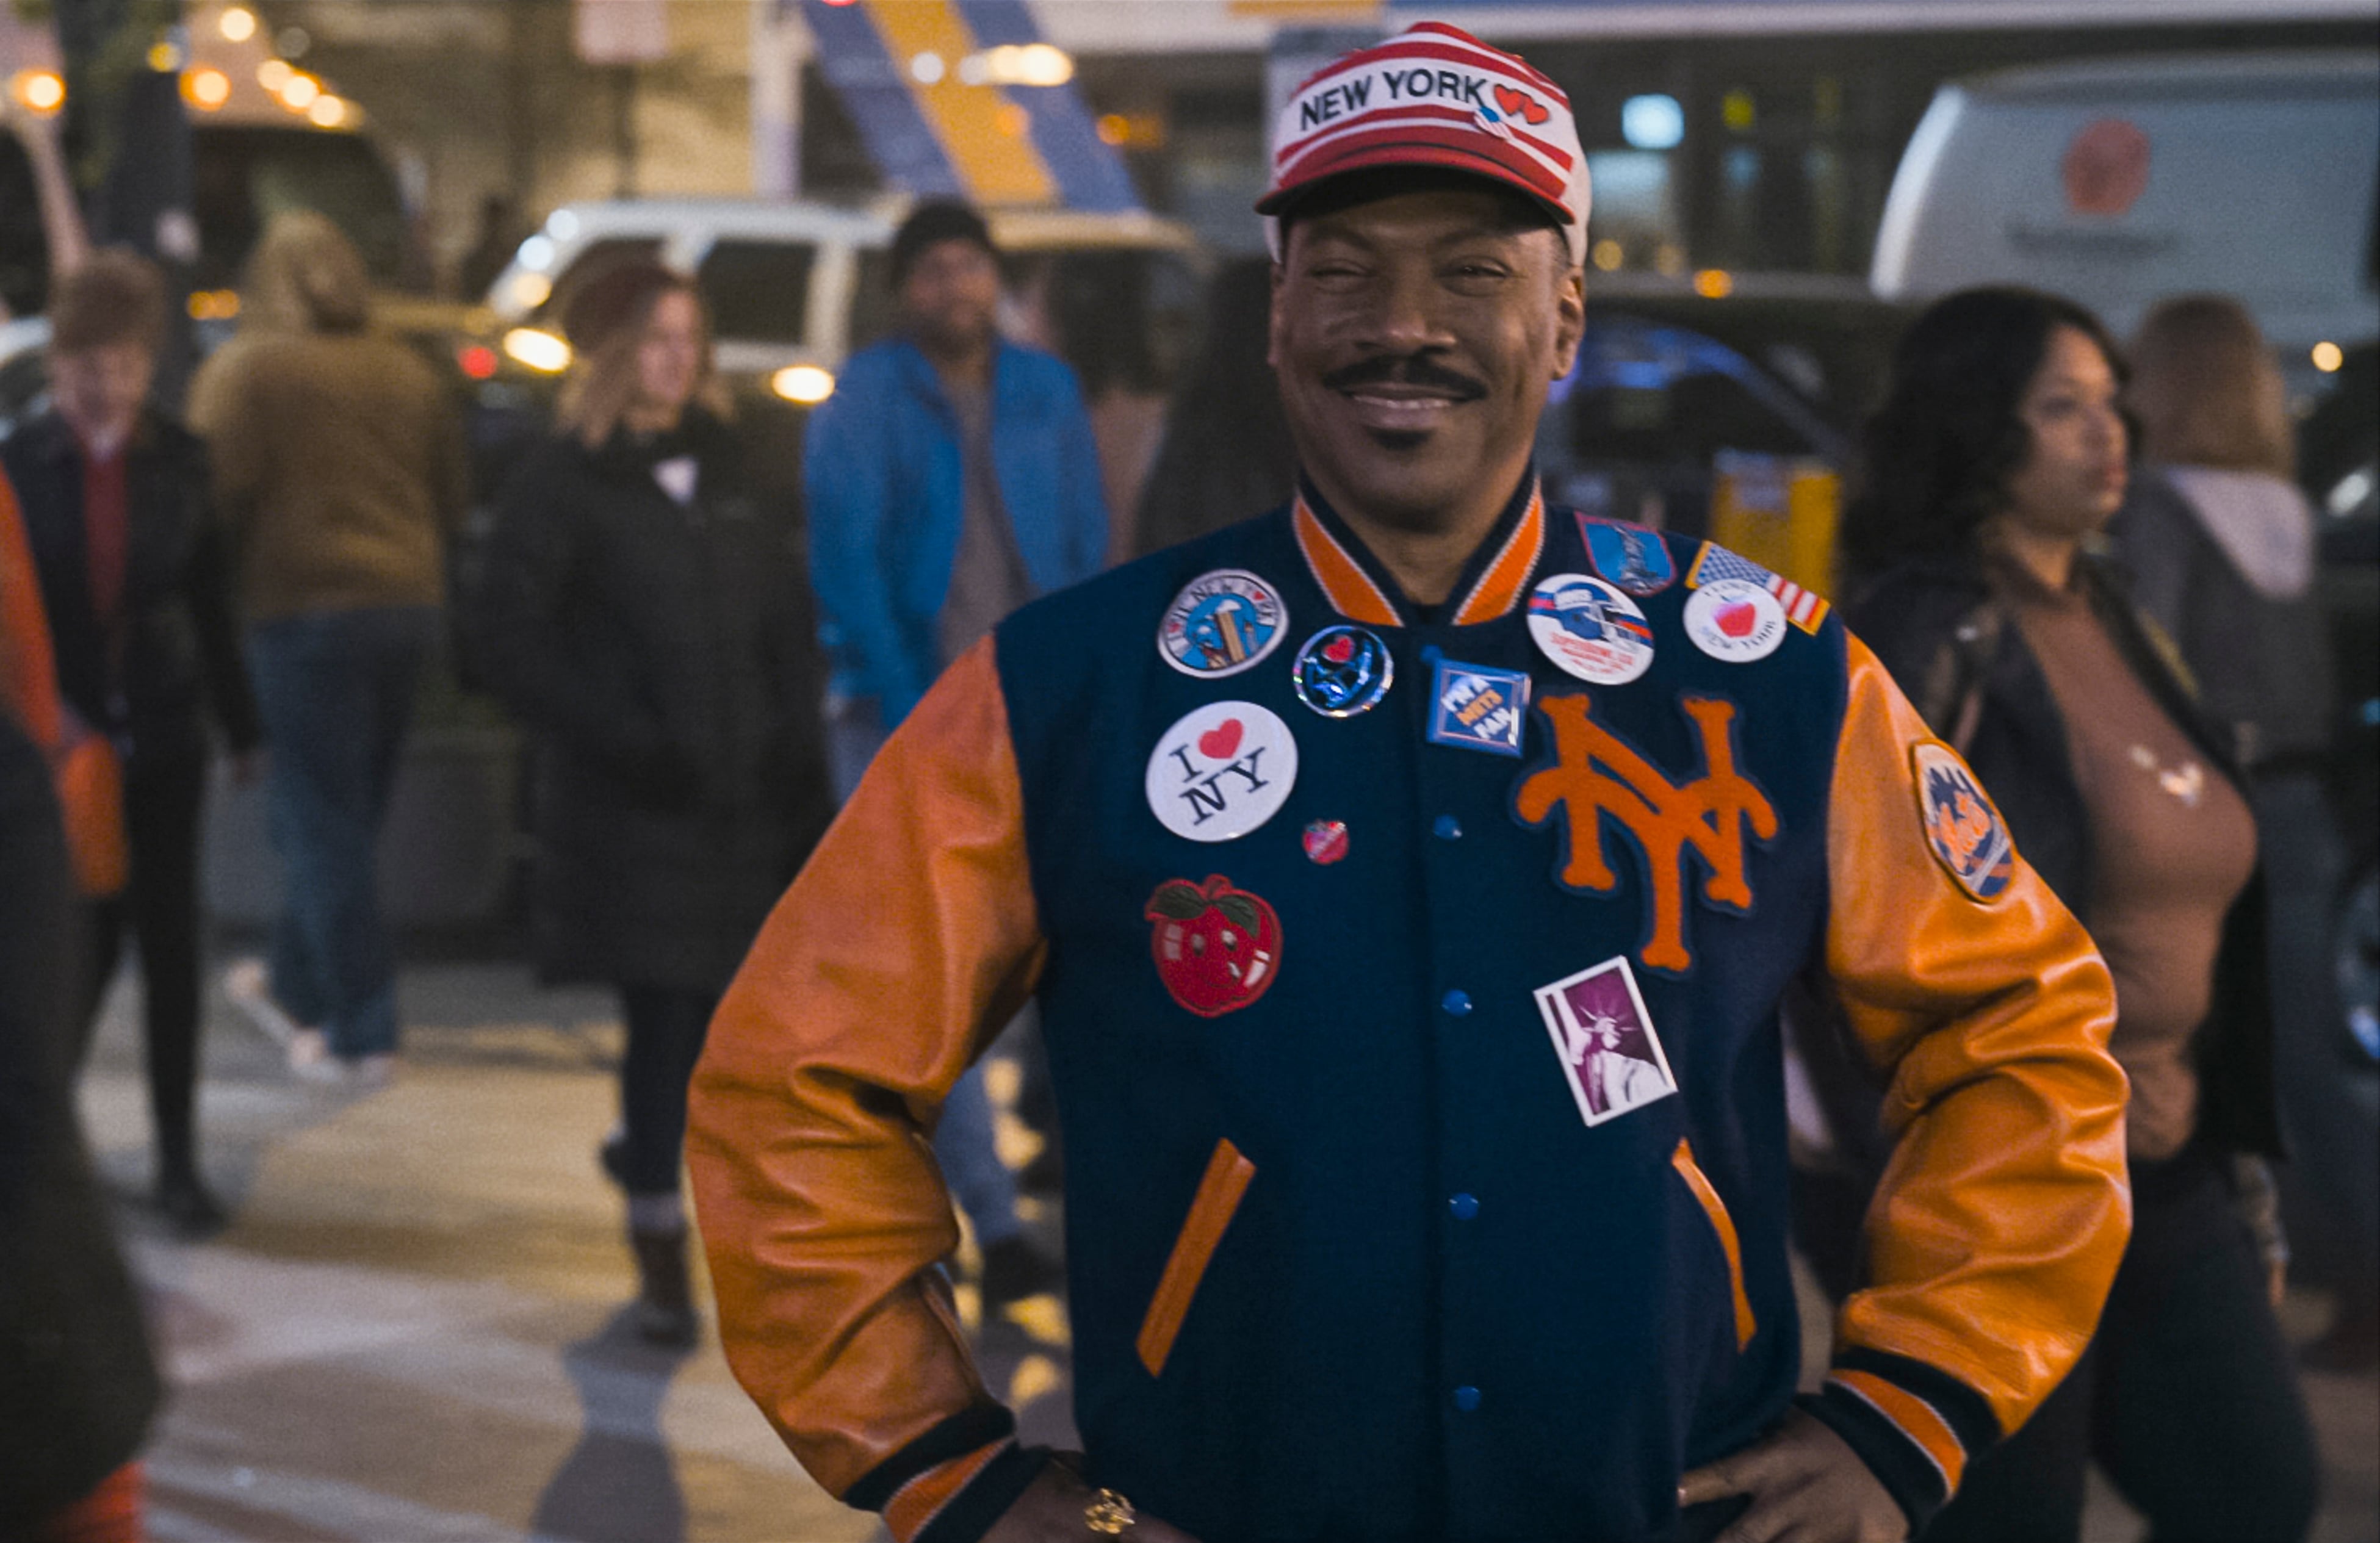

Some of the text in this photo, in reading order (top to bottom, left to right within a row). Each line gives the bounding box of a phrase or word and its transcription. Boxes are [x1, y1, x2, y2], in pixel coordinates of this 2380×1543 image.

[1300, 68, 1487, 131] NEW YORK
[1169, 744, 1203, 783] I
[1179, 746, 1269, 826] NY
[1516, 693, 1778, 972] NY
